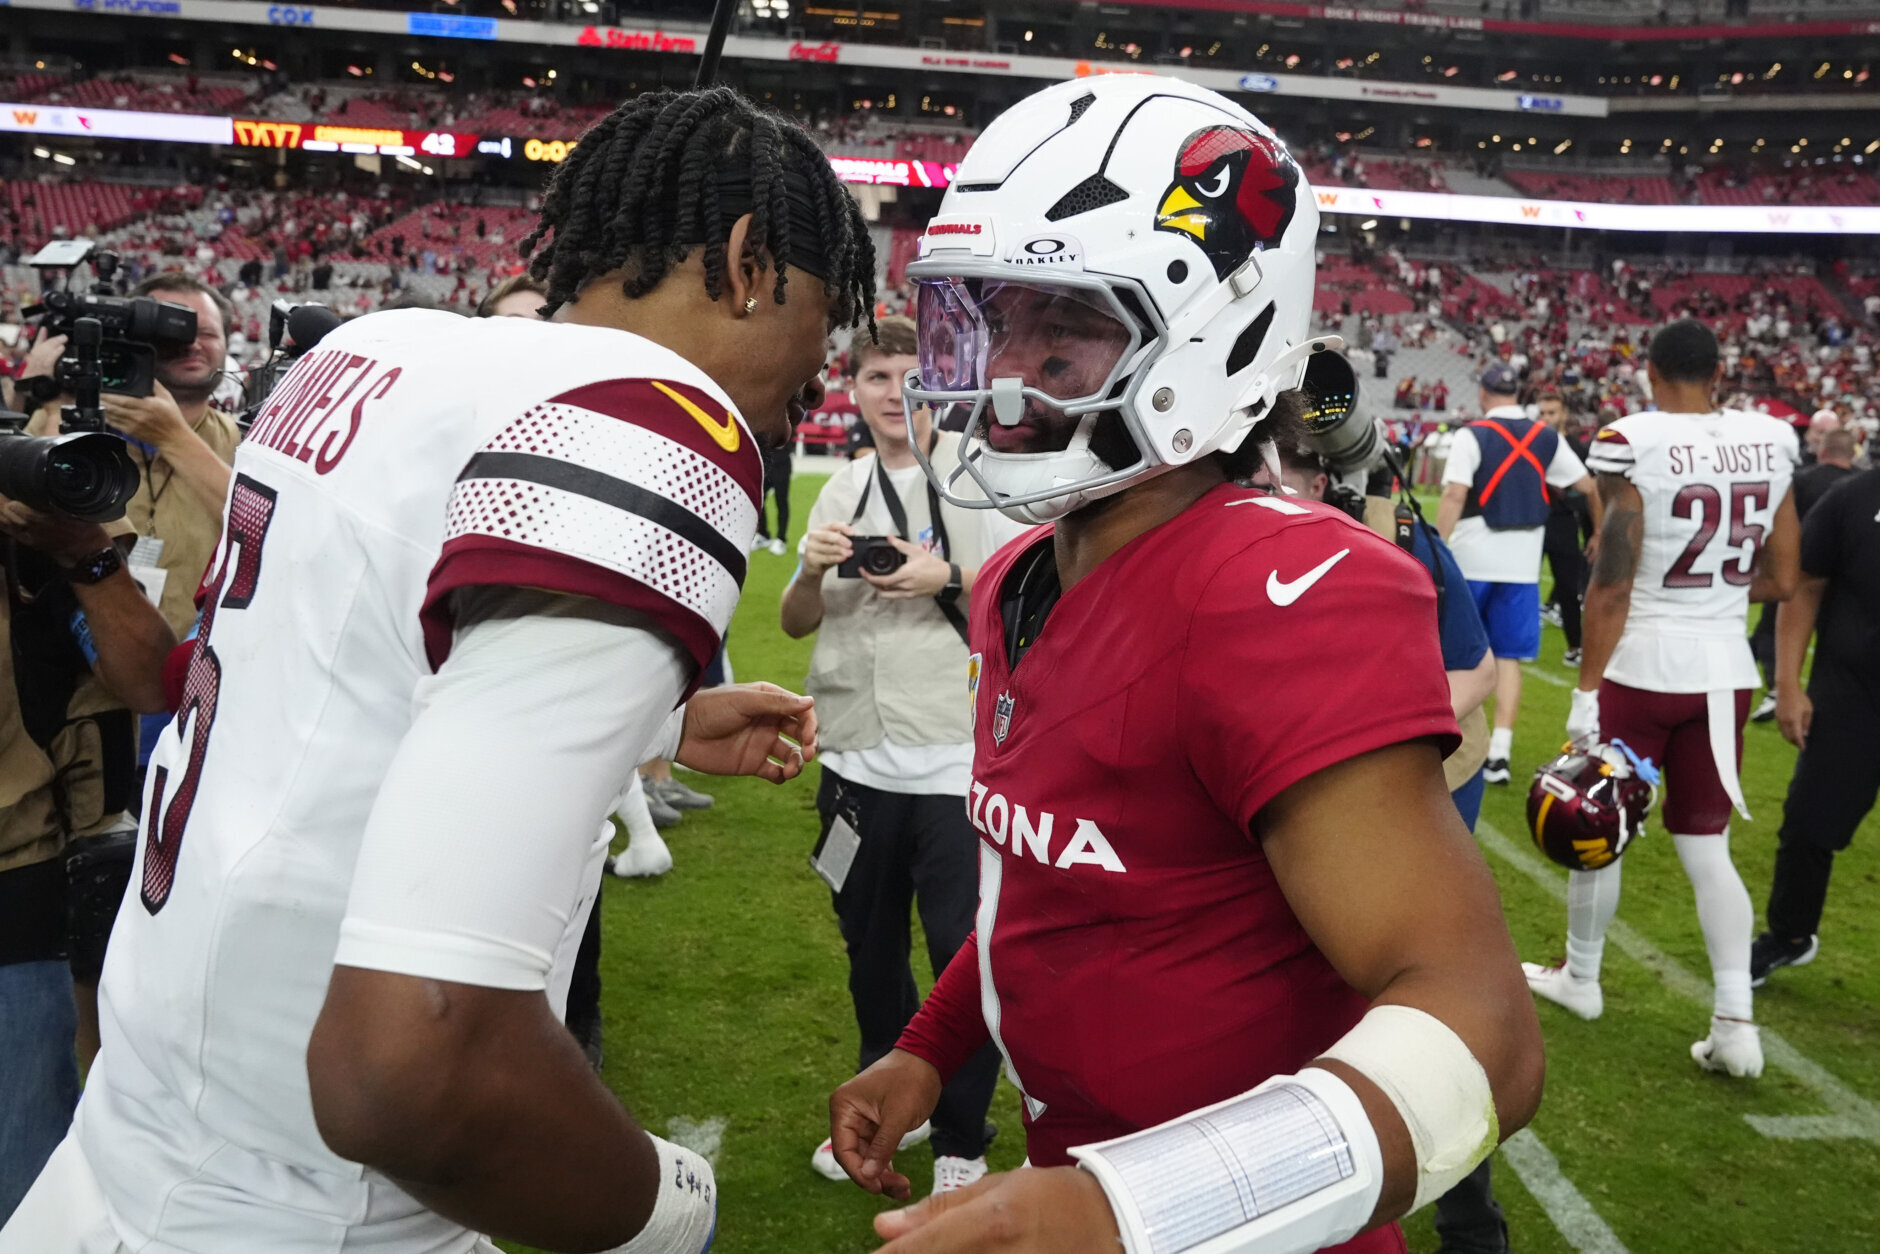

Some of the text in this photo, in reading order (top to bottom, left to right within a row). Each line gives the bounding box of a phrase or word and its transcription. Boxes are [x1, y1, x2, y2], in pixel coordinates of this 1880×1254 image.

[267, 7, 314, 24] COX
[605, 28, 695, 53] State Farm
[421, 133, 455, 155] 42
[1669, 443, 1775, 475] ST-JUSTE
[1663, 481, 1770, 588] 25
